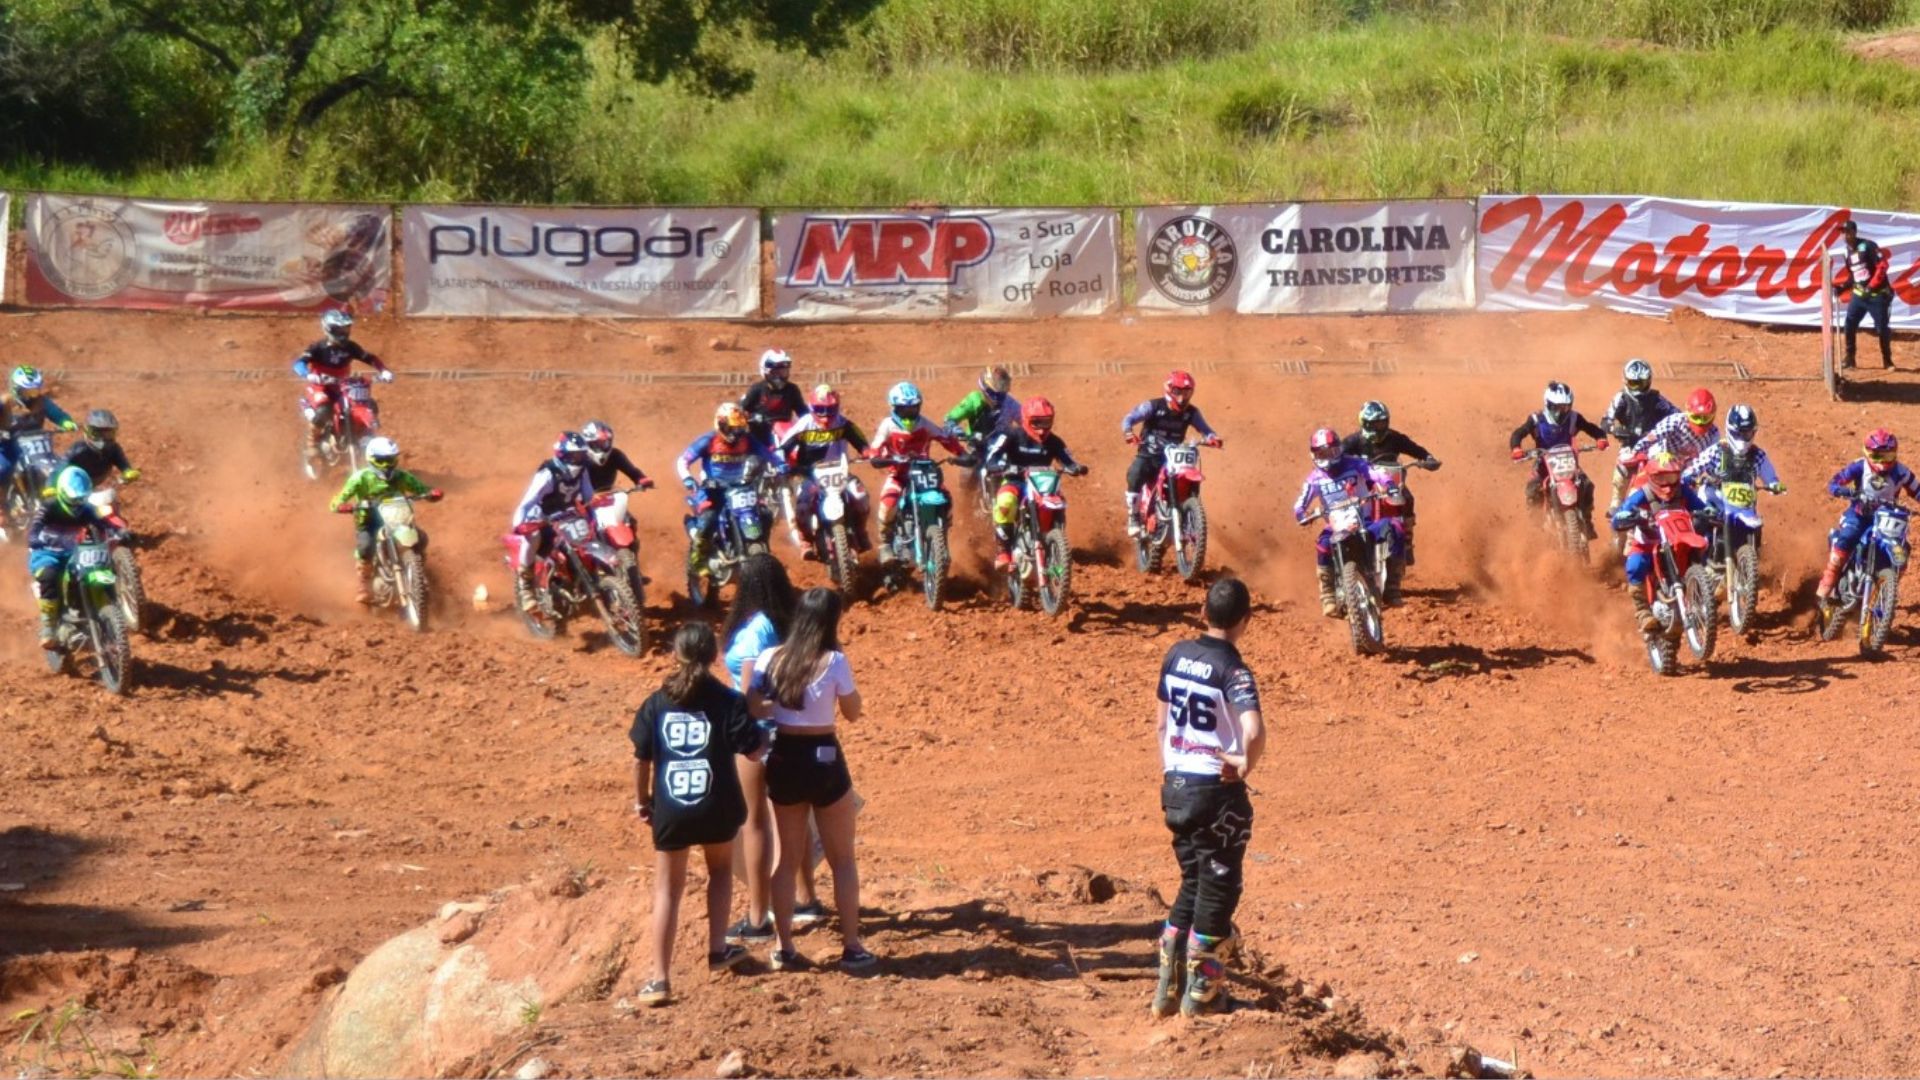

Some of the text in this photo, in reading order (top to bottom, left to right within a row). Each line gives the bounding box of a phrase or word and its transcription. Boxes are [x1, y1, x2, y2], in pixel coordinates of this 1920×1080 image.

[1019, 221, 1075, 239] a Sua
[1261, 225, 1450, 254] CAROLINA
[785, 215, 994, 287] MRP
[1151, 220, 1233, 266] CAROLINA
[1029, 250, 1073, 274] Loja
[1050, 274, 1103, 297] Road
[1266, 265, 1447, 288] TRANSPORTES
[1174, 452, 1196, 464] 06
[917, 472, 938, 489] 45
[1037, 475, 1055, 492] 7
[1170, 686, 1217, 732] 56
[670, 720, 705, 748] 98
[673, 769, 708, 796] 99
